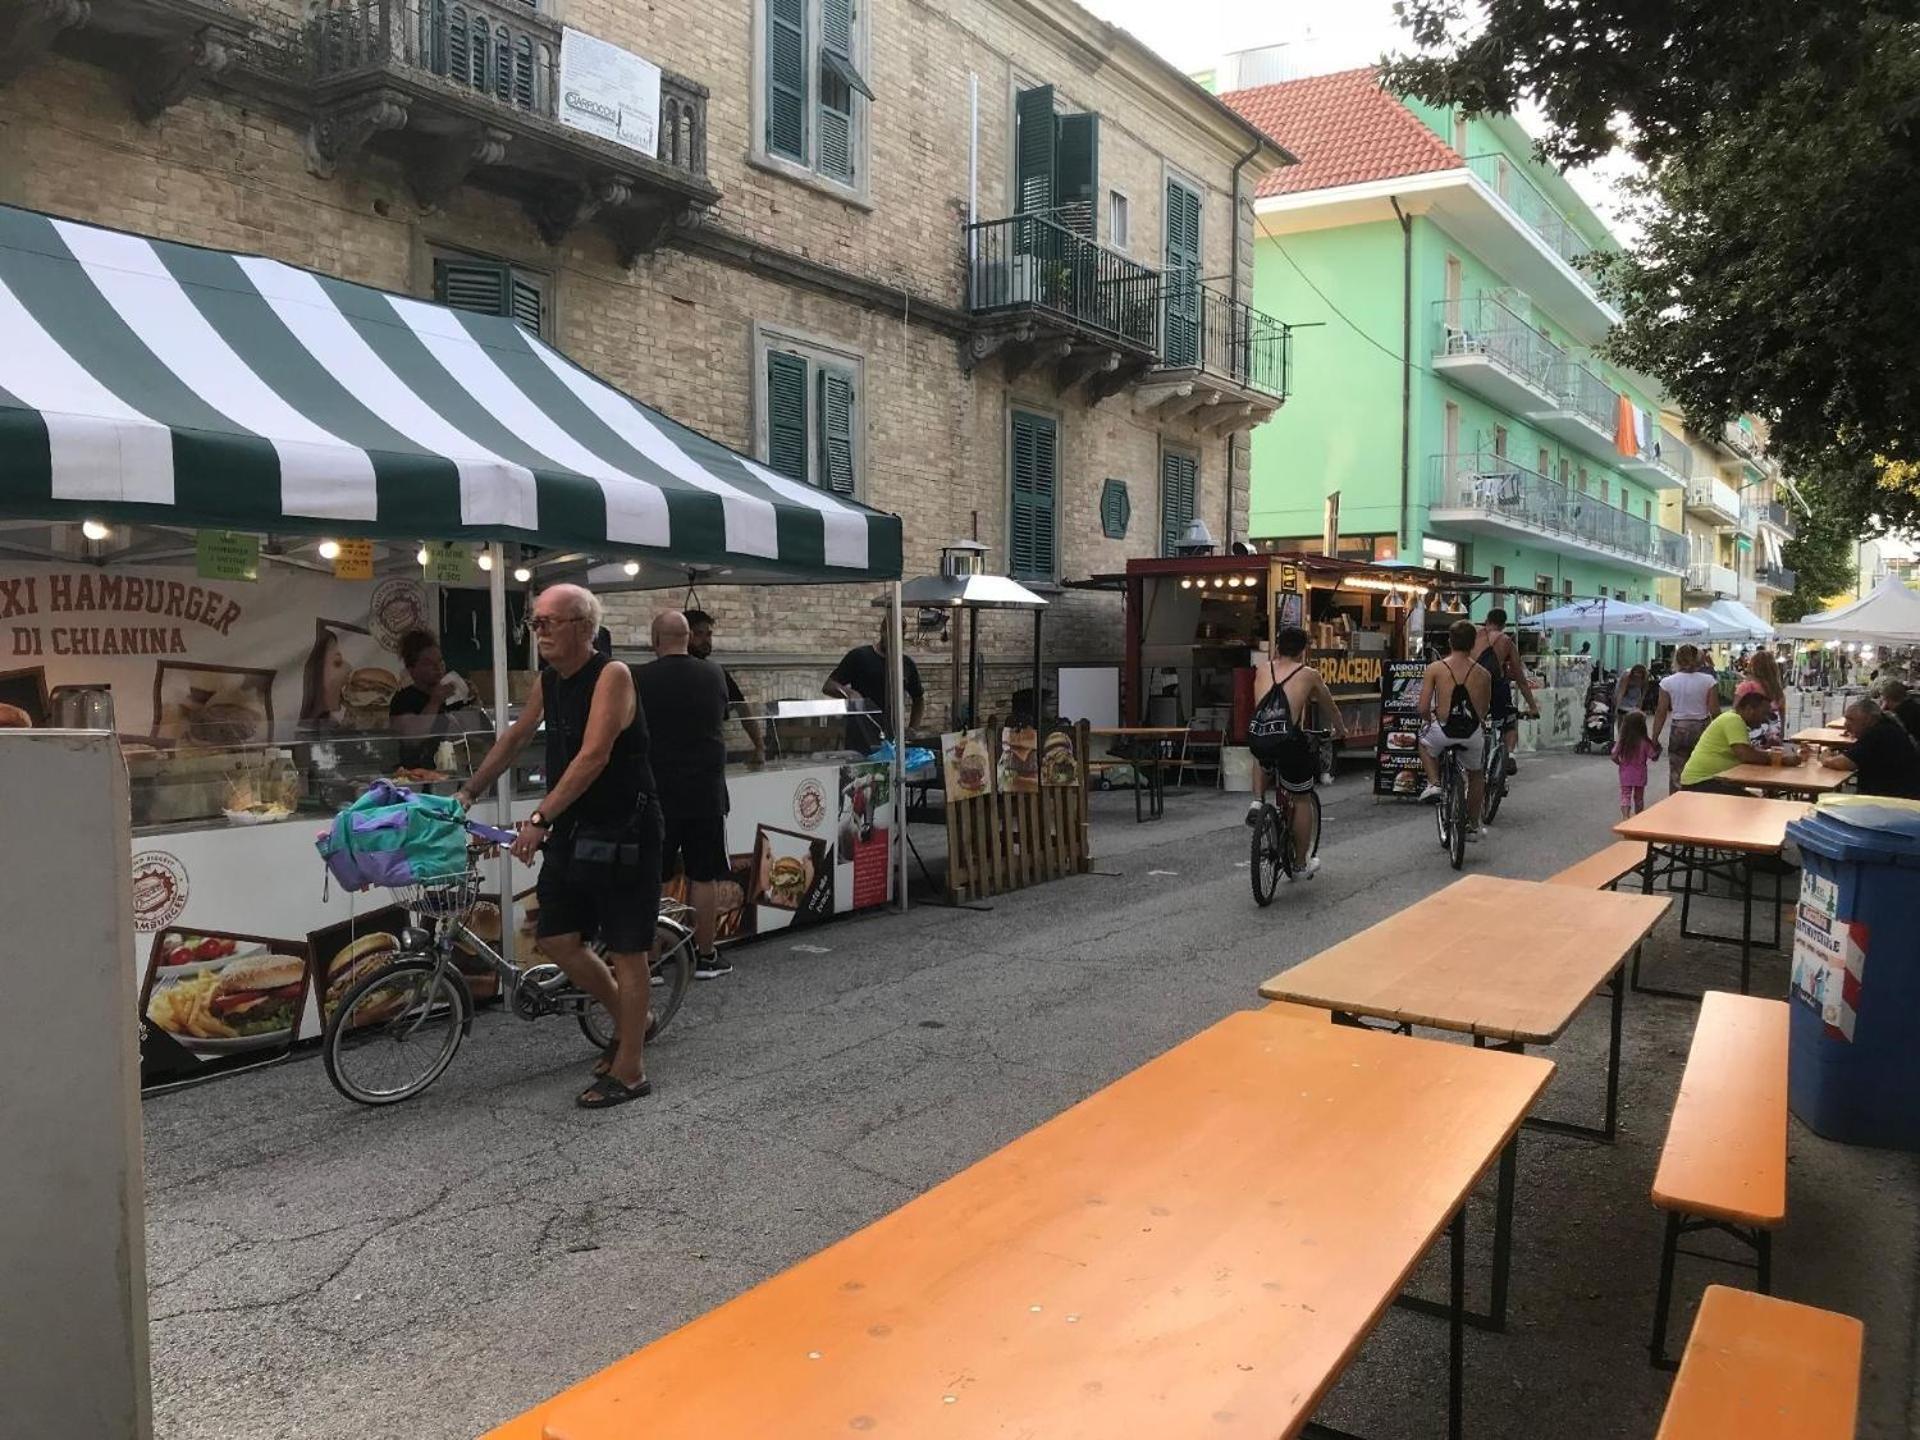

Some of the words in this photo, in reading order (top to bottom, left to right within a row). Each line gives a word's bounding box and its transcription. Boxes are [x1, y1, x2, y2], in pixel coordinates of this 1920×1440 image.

[0, 578, 38, 618] XI
[50, 573, 241, 637] HAMBURGER
[12, 627, 43, 655] DI
[51, 626, 187, 655] CHIANINA
[1319, 656, 1382, 685] BRACERIA
[1389, 663, 1427, 672] ARROSTI
